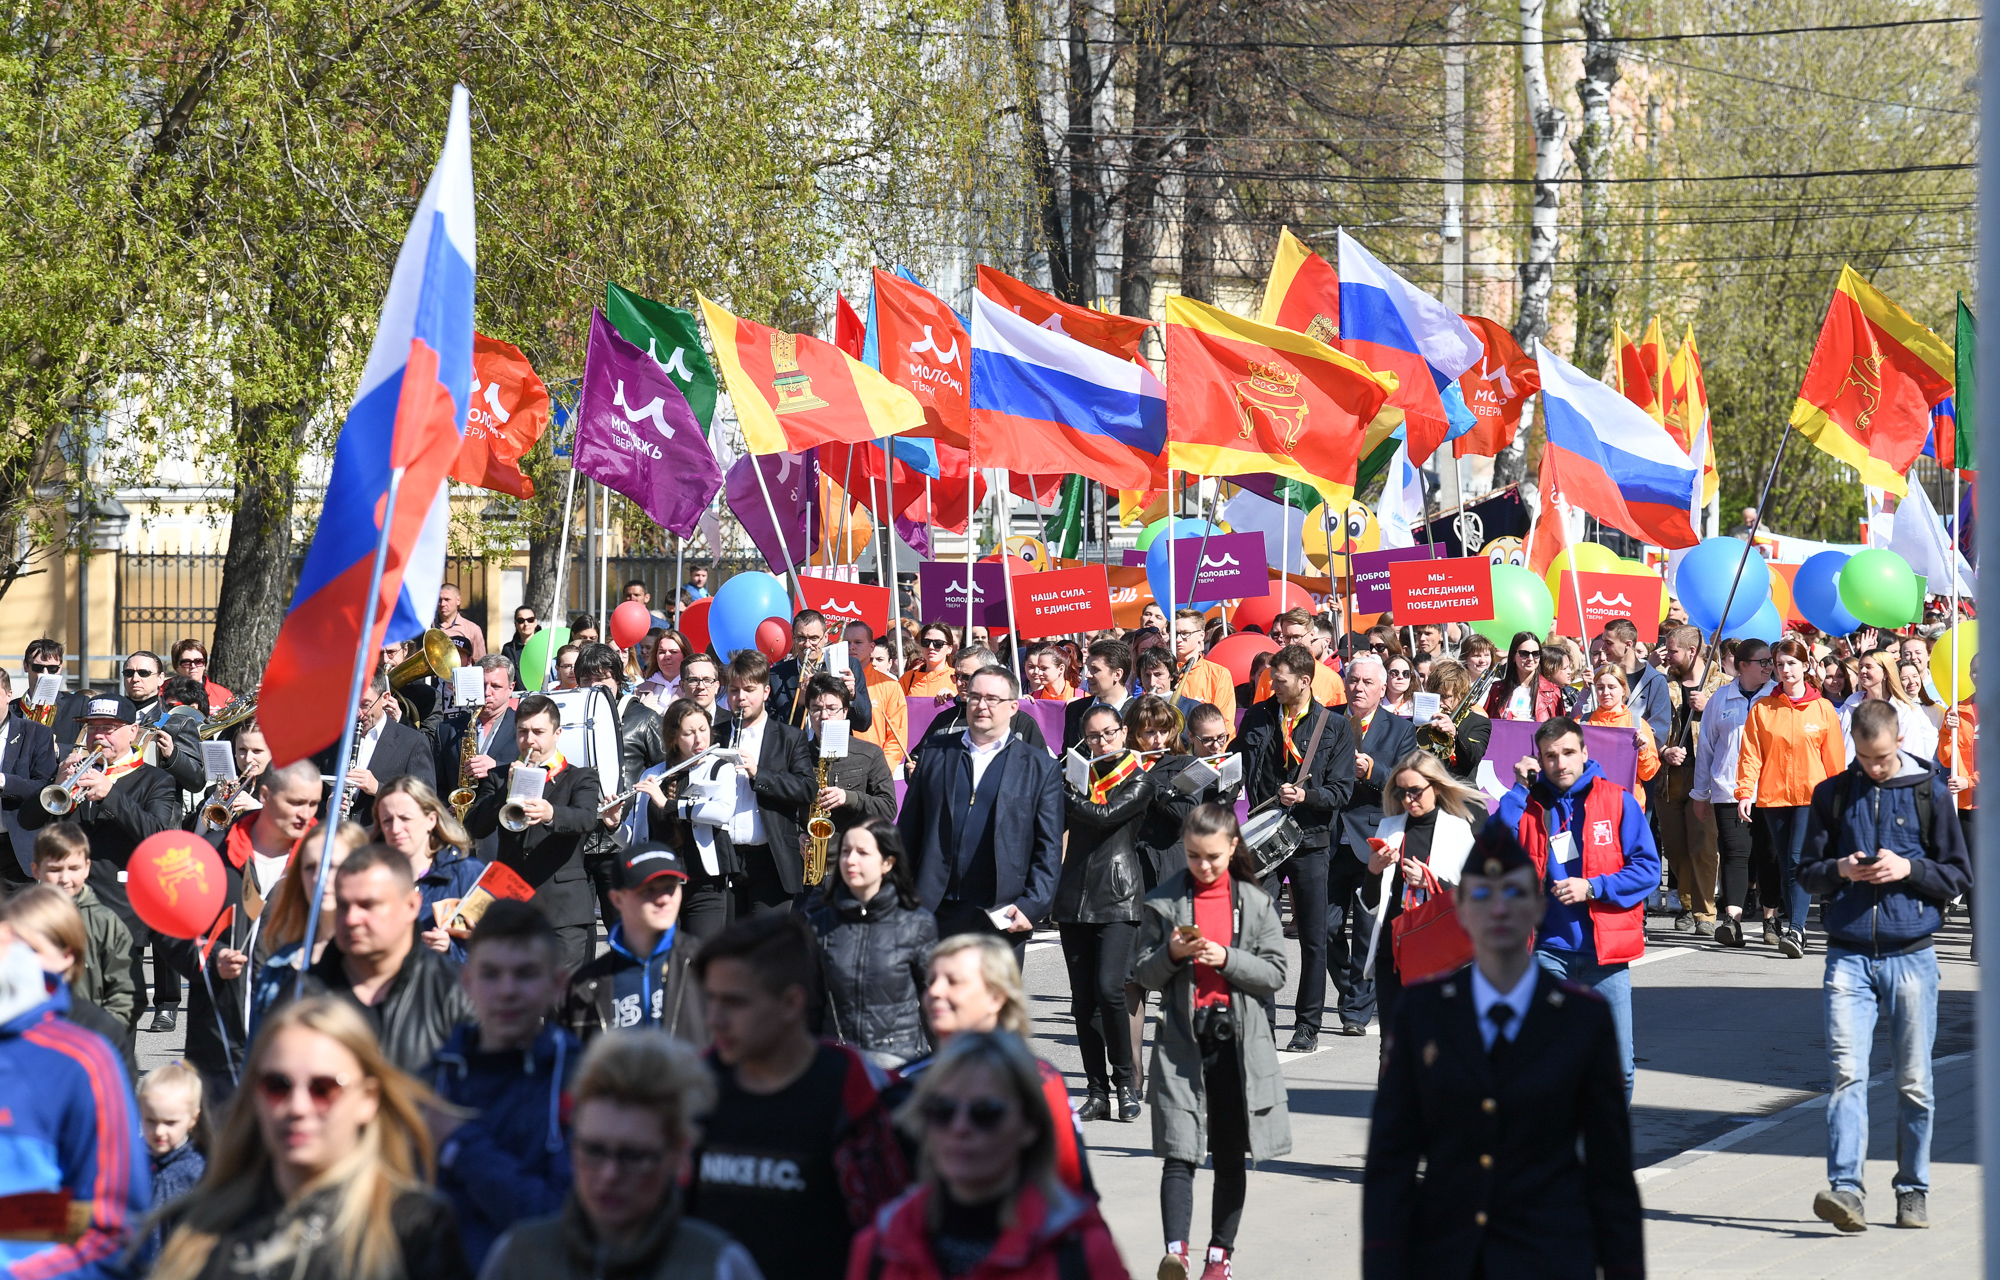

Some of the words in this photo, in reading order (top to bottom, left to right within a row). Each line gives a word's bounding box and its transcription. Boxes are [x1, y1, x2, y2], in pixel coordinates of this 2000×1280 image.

[1356, 570, 1391, 582] ДОБРОВ
[1428, 573, 1445, 581] МЫ
[1031, 592, 1058, 602] НАША
[1060, 588, 1085, 598] СИЛА
[1408, 585, 1475, 596] НАСЛЕДНИКИ
[1035, 607, 1042, 615] В
[1044, 601, 1091, 615] ЕДИНСТВЕ
[1407, 596, 1479, 610] ПОБЕДИТЕЛЕЙ
[1586, 607, 1631, 617] МОЛОДЕЖЬ
